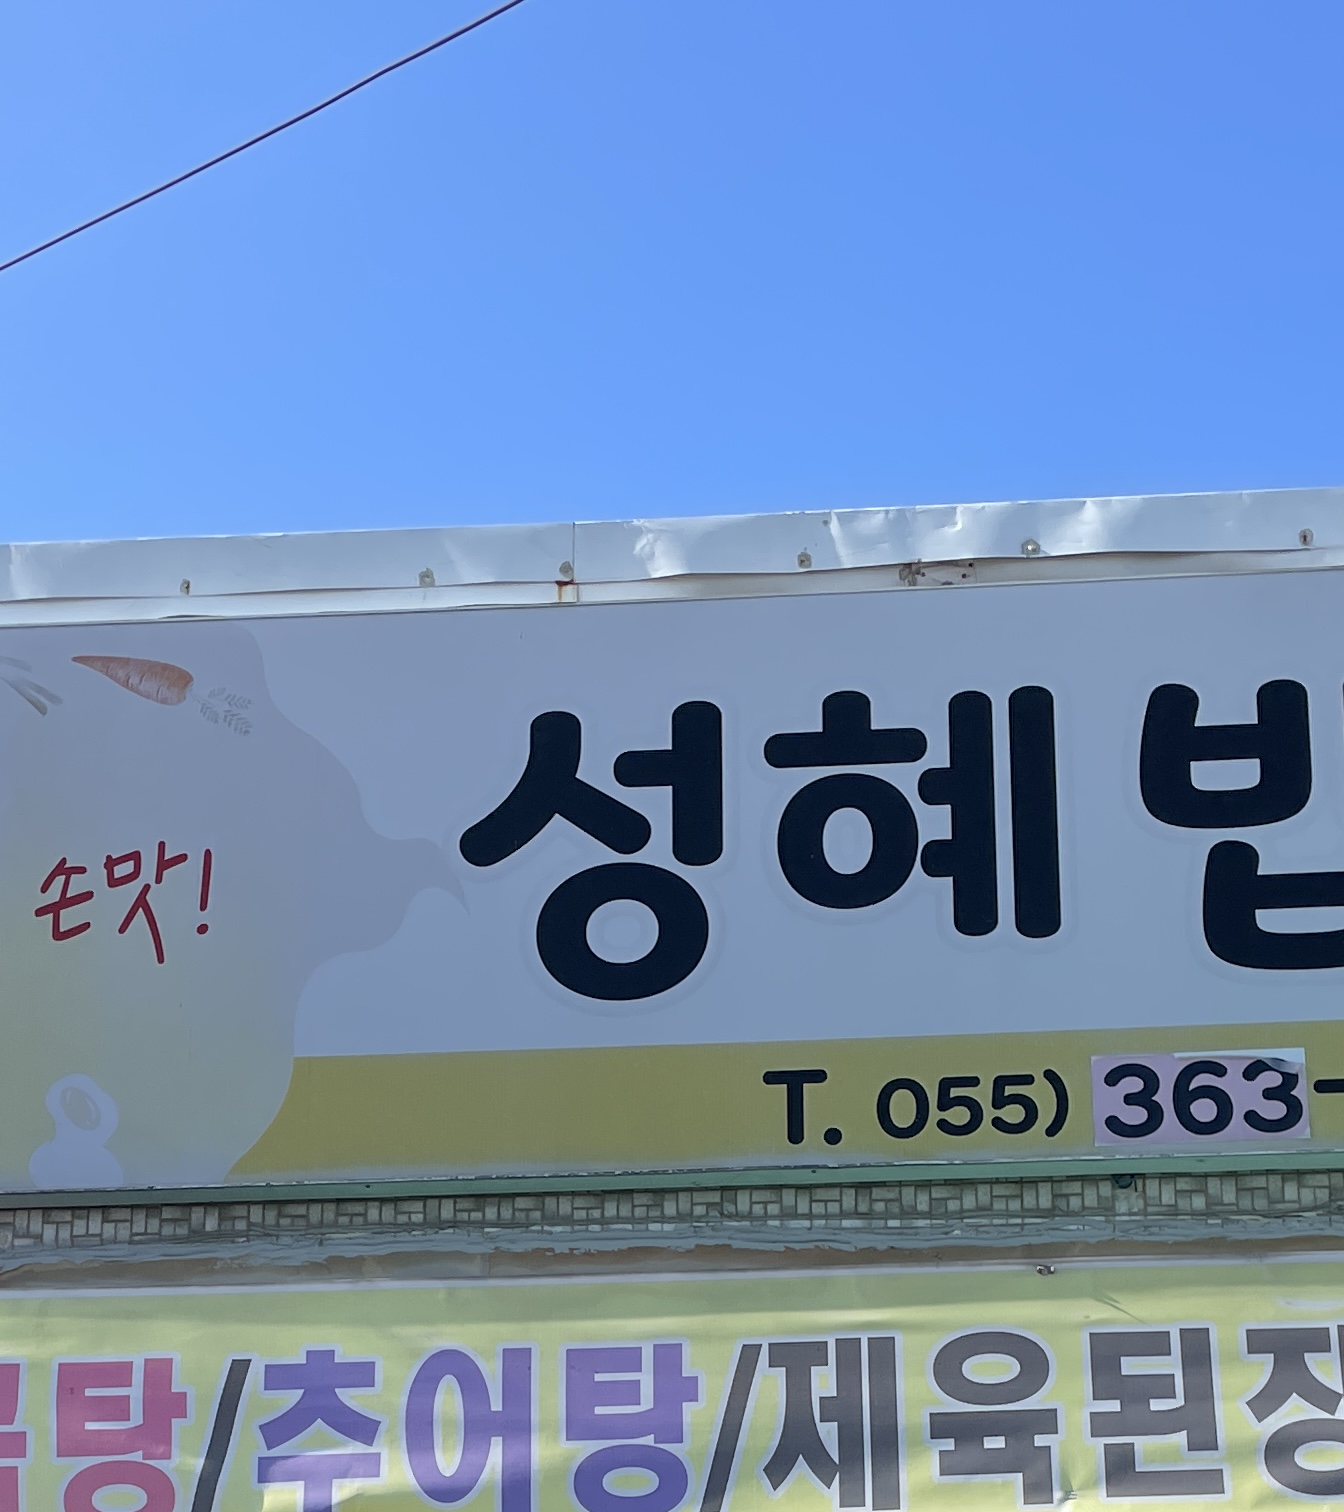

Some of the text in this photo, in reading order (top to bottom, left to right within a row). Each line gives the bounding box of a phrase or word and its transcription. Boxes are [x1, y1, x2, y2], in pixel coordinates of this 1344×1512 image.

[33, 841, 214, 964] 손맛!
[763, 1068, 843, 1146] T.
[875, 1068, 1070, 1140] 055)
